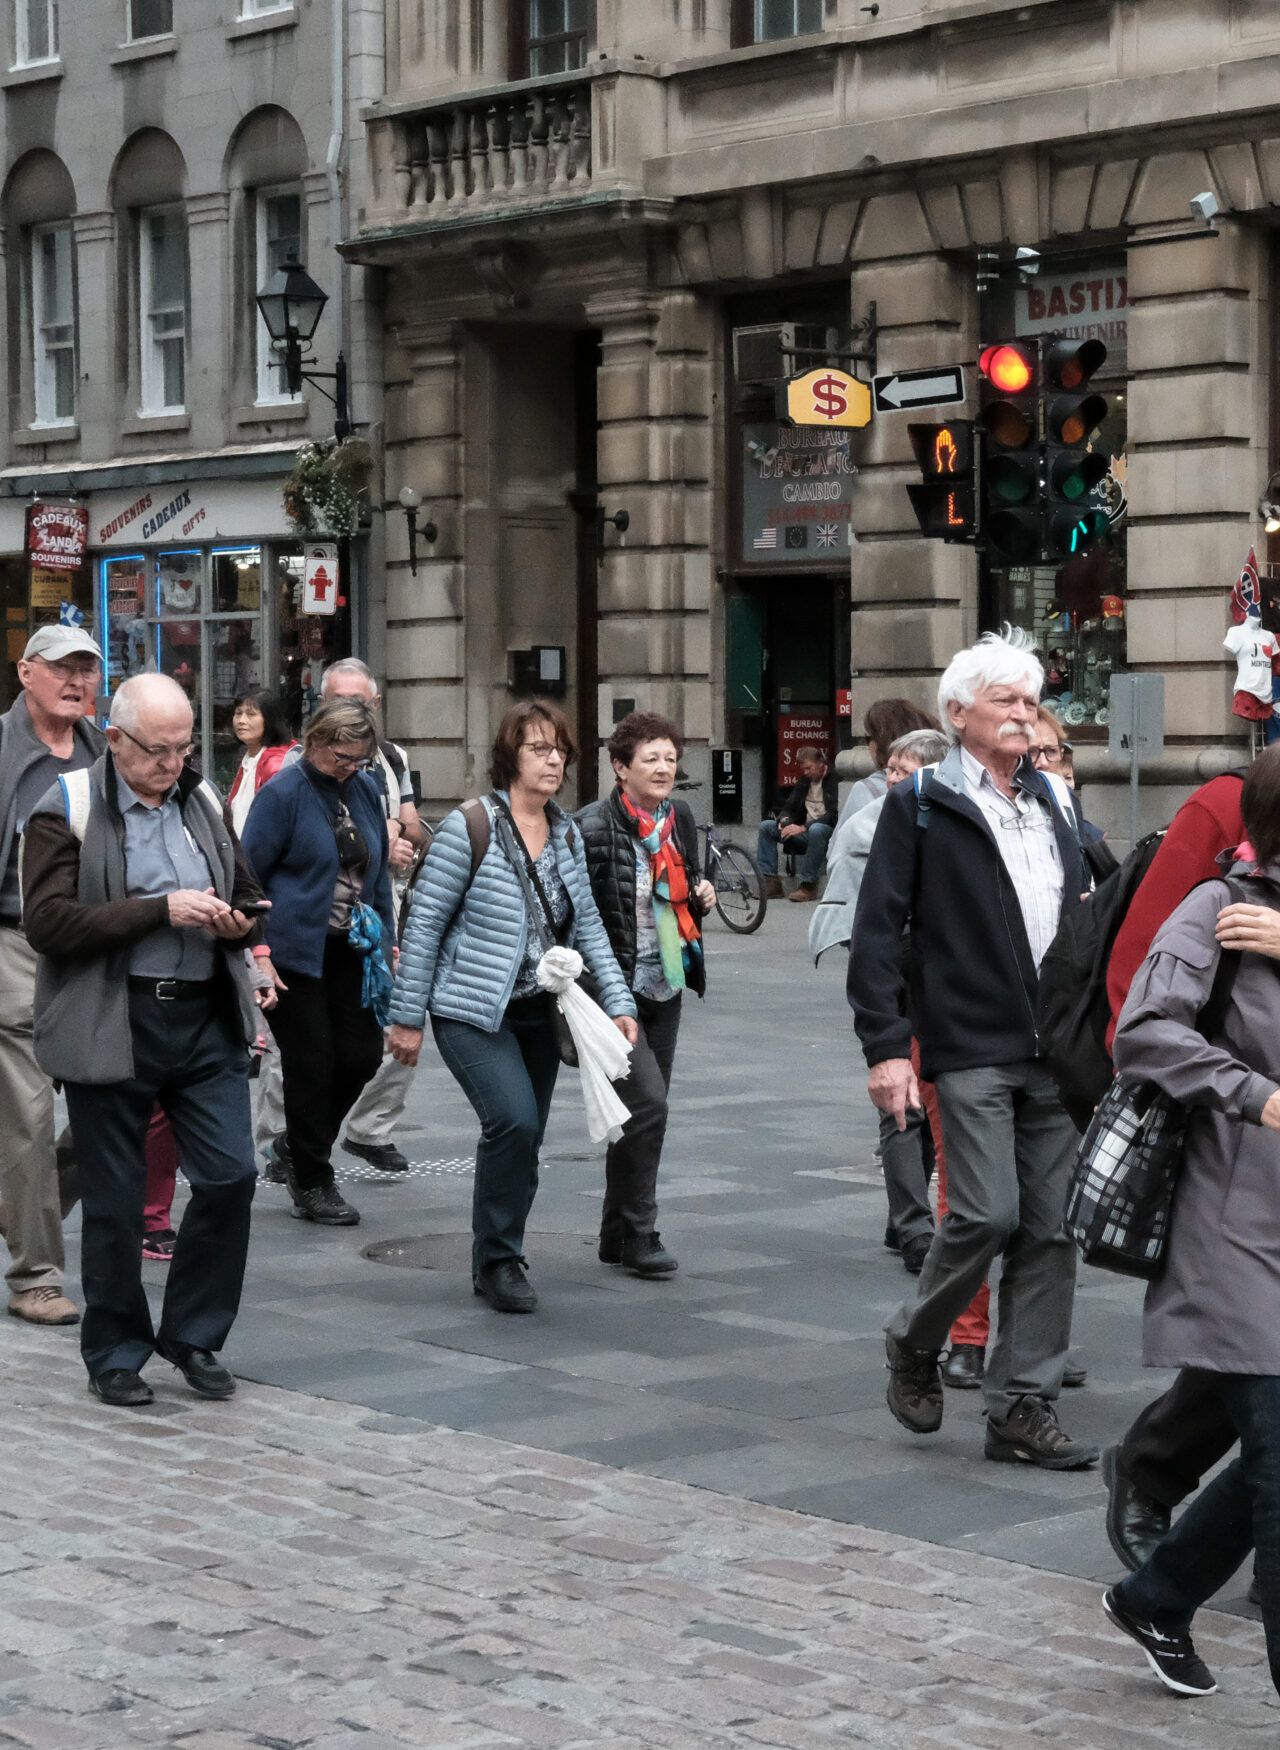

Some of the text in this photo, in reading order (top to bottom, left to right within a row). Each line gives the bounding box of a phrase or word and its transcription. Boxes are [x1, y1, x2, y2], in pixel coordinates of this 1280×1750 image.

[812, 374, 847, 420] $
[790, 452, 859, 477] CHANG
[782, 481, 842, 502] CAMBIO
[32, 512, 86, 531] CADEAUX
[100, 493, 153, 543] SOUVENIRS
[142, 488, 191, 539] CADEAUX
[182, 508, 206, 536] GIFTS
[31, 552, 82, 566] SOUVENIRS
[840, 704, 851, 714] DE
[790, 719, 823, 728] BUREAU
[783, 731, 830, 740] DE CHANGE
